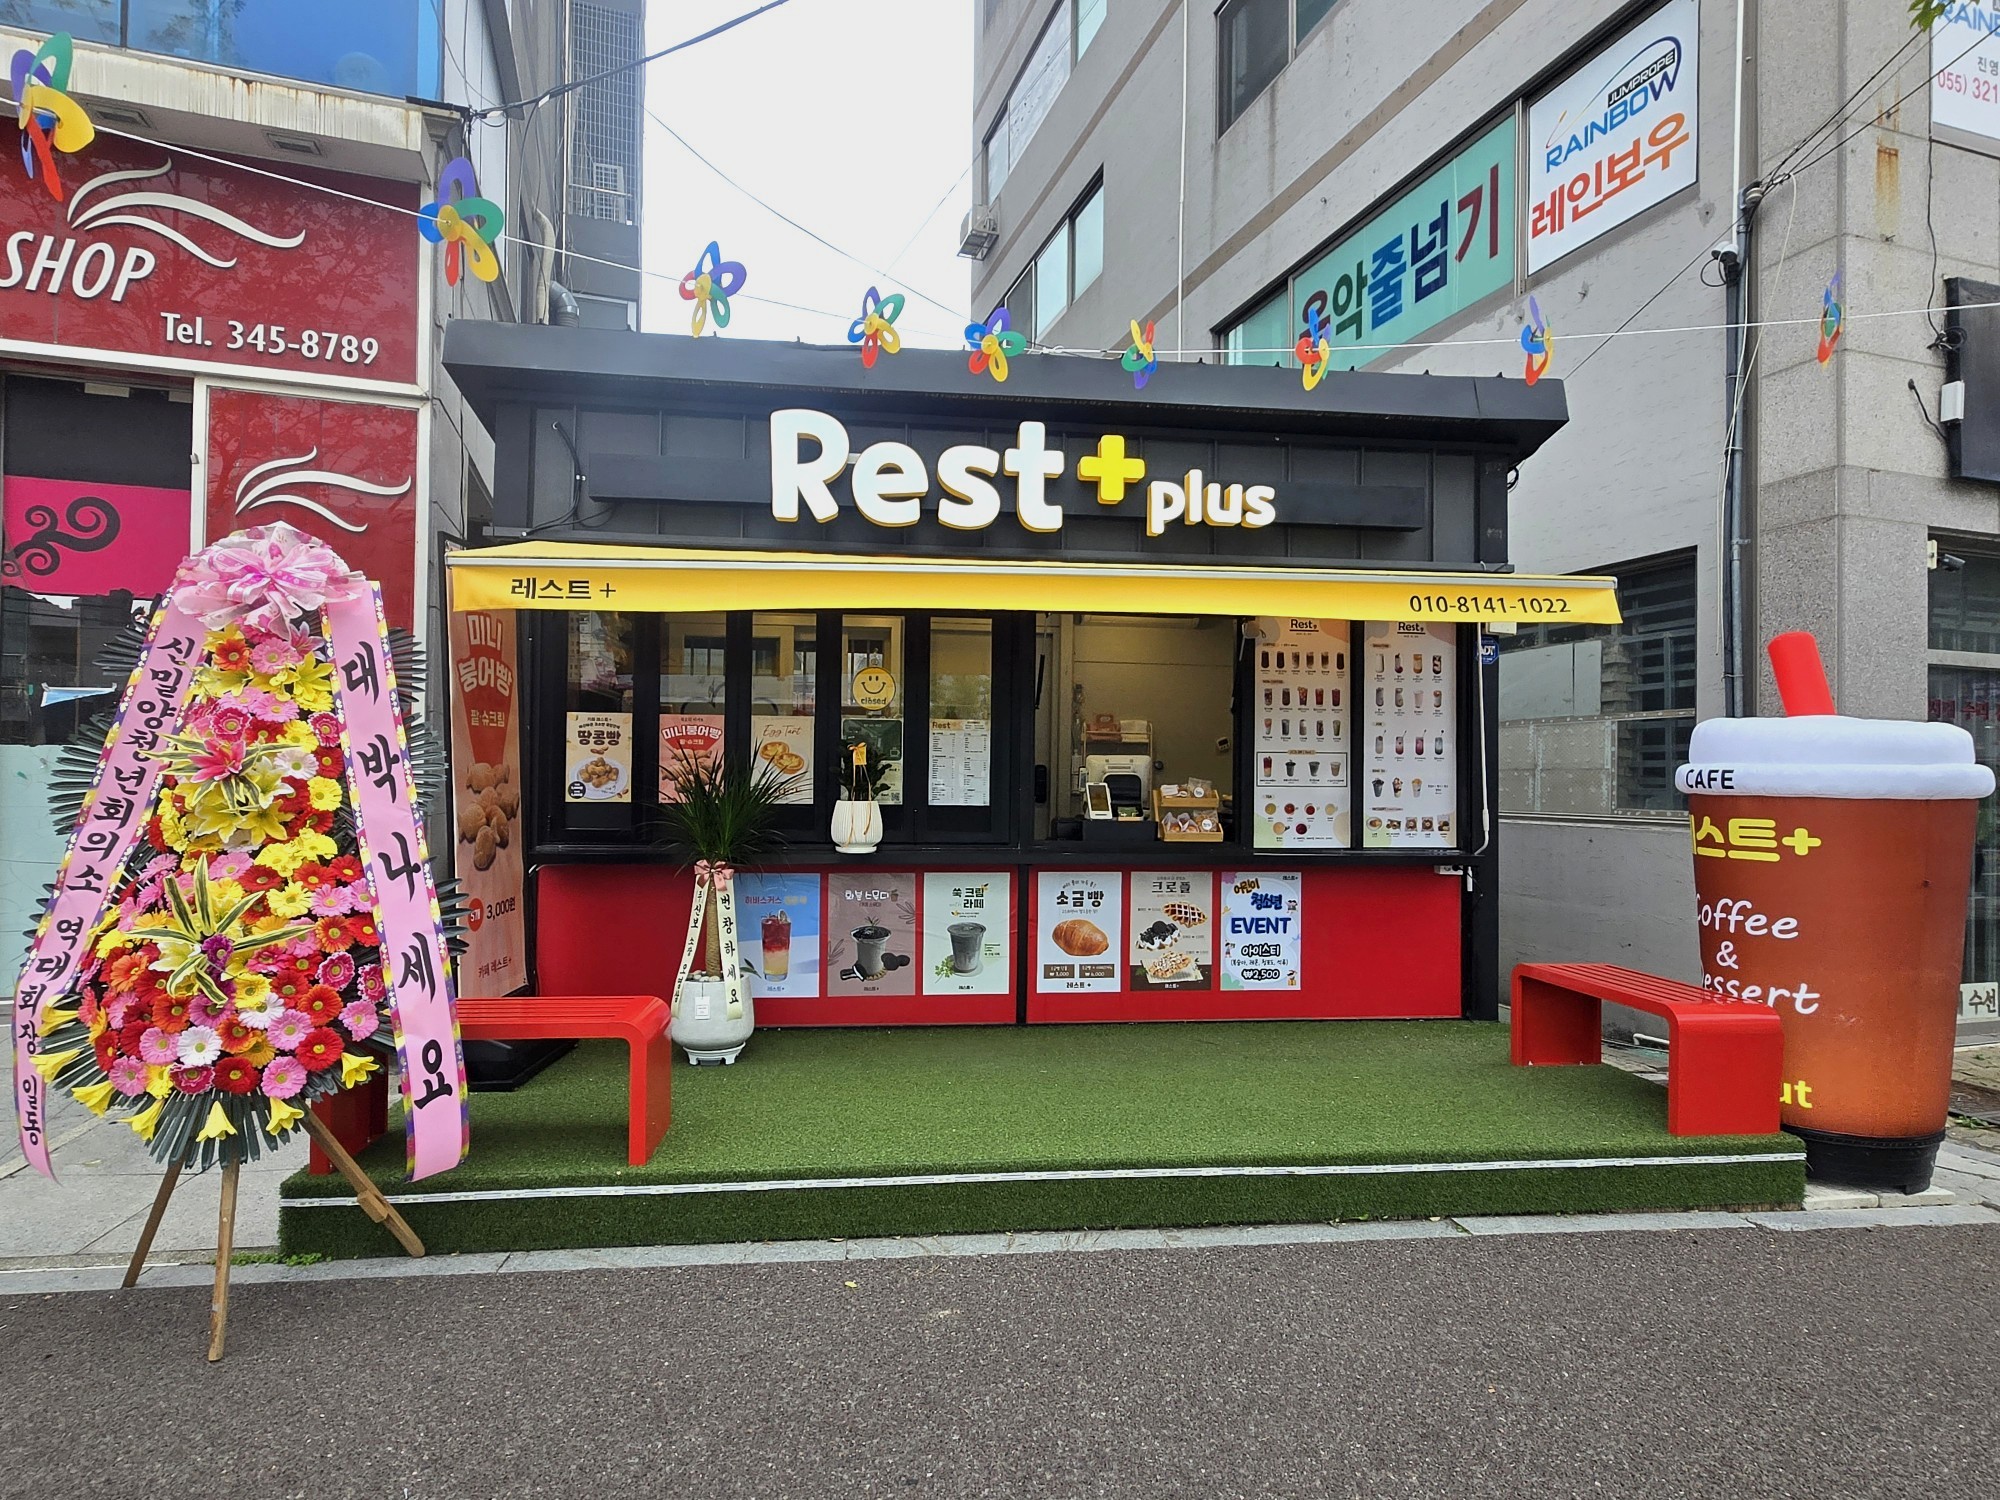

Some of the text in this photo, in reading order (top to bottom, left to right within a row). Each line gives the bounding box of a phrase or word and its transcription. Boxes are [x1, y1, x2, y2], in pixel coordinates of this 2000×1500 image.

[1608, 49, 1676, 106] JUMPROPE
[1546, 70, 1676, 174] RAINBOW
[1531, 112, 1690, 240] 레인보우
[0, 231, 156, 303] SHOP
[160, 311, 379, 365] Tel. 345-8789
[770, 408, 1065, 533] Rest
[1146, 468, 1277, 536] plus
[511, 577, 591, 600] 레스트
[1409, 594, 1572, 614] 010-8141-1022
[467, 614, 502, 652] 미니
[457, 655, 513, 697] 붕어빵
[763, 724, 782, 738] Egg
[1685, 768, 1735, 790] CAFE
[1690, 814, 1822, 863] 스트+
[340, 640, 453, 1110] 대박나세요
[1151, 881, 1191, 894] 크로플
[963, 899, 984, 909] 라떼
[964, 887, 984, 898] 크림
[1056, 890, 1105, 908] 소금빵
[1230, 917, 1292, 935] EVENT
[1696, 893, 1799, 940] offee
[1241, 943, 1281, 957] 아이스티
[1716, 940, 1739, 970] &
[1702, 972, 1821, 1015] essert
[1968, 988, 1997, 1016] 수선
